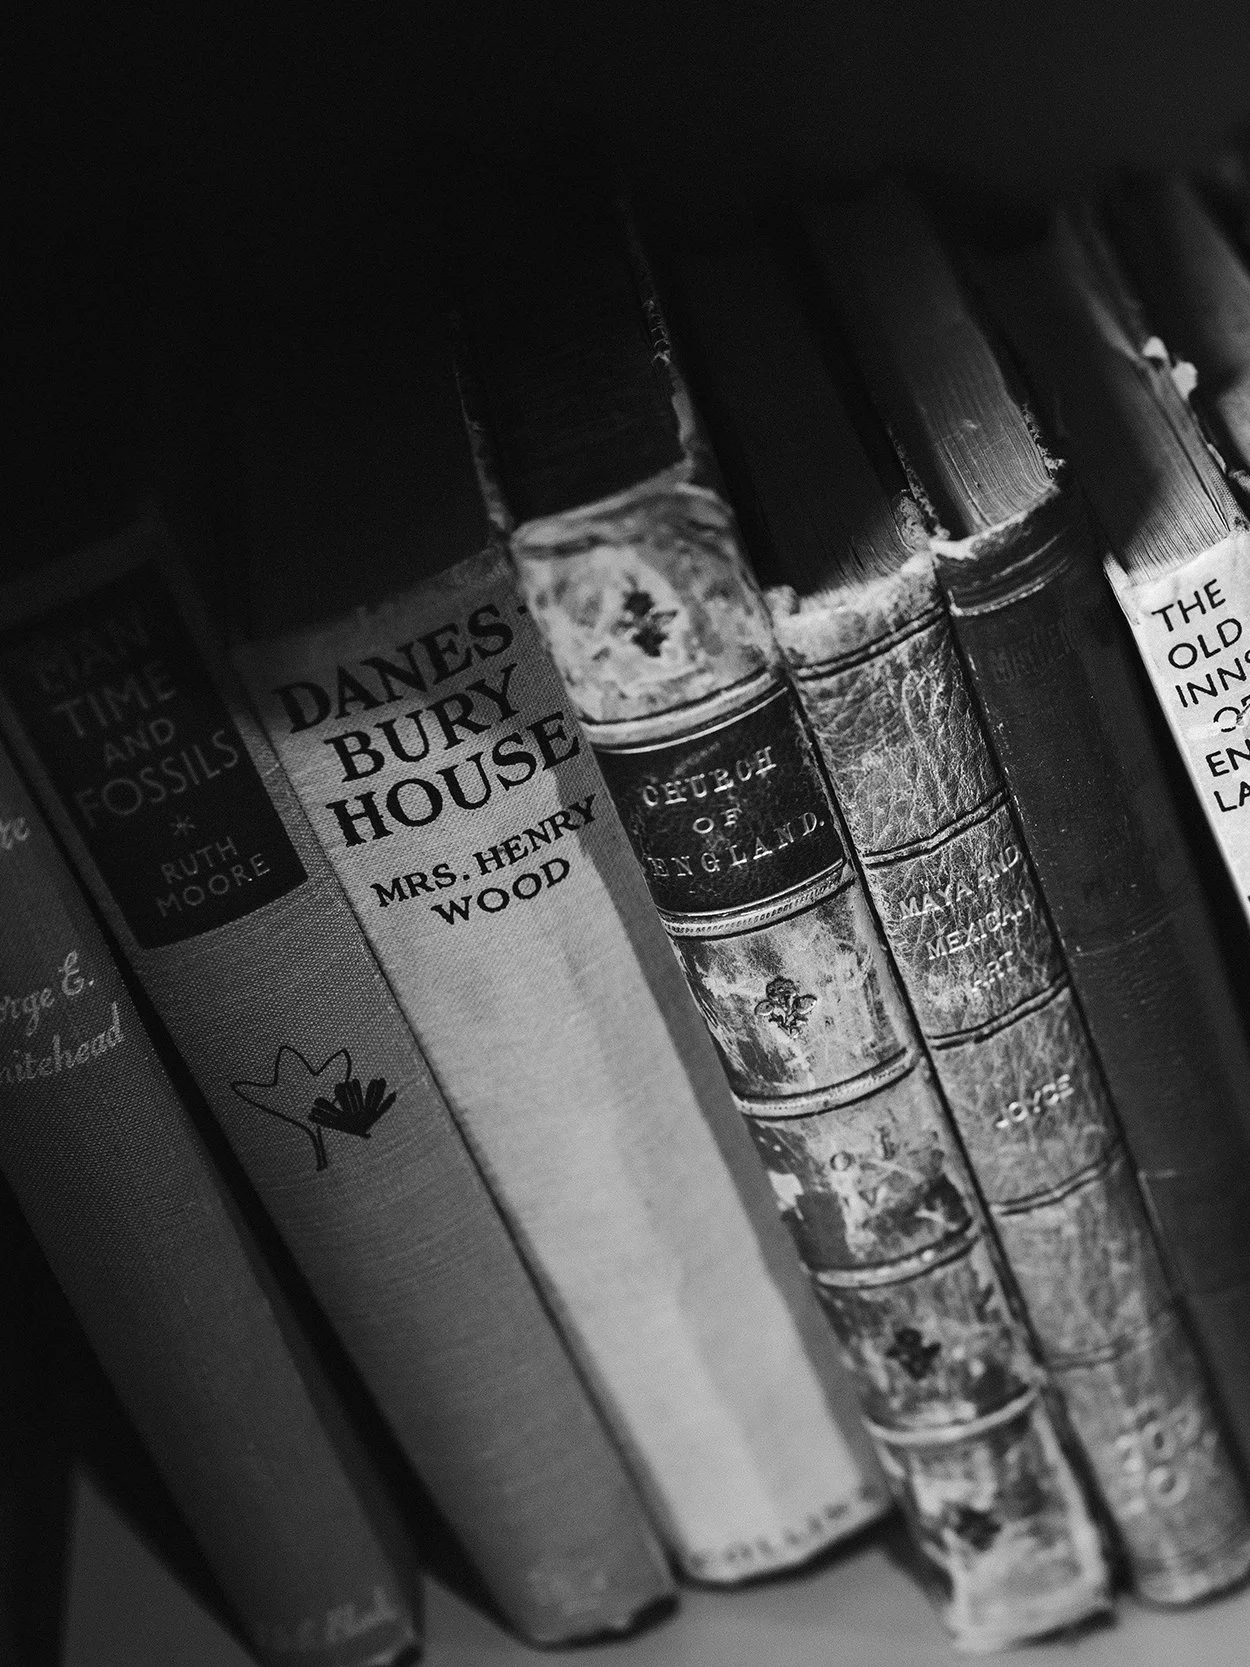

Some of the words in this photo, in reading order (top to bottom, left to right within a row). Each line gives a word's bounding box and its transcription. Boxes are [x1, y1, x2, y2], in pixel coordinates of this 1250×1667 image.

[1151, 578, 1227, 632] THE
[1168, 617, 1243, 669] OLD
[51, 659, 178, 738] TIME
[323, 662, 520, 783] BURY
[103, 717, 176, 770] AND
[73, 729, 239, 829] FOSSILS
[325, 711, 581, 848] HOUSE
[642, 745, 777, 807] CHURCH
[370, 863, 470, 908] MRS.
[472, 793, 597, 875] HENRY
[692, 806, 743, 834] OF
[155, 853, 271, 918] MOORE
[161, 835, 239, 885] RUTH
[431, 857, 571, 926] WOOD
[899, 878, 974, 920] MAYA
